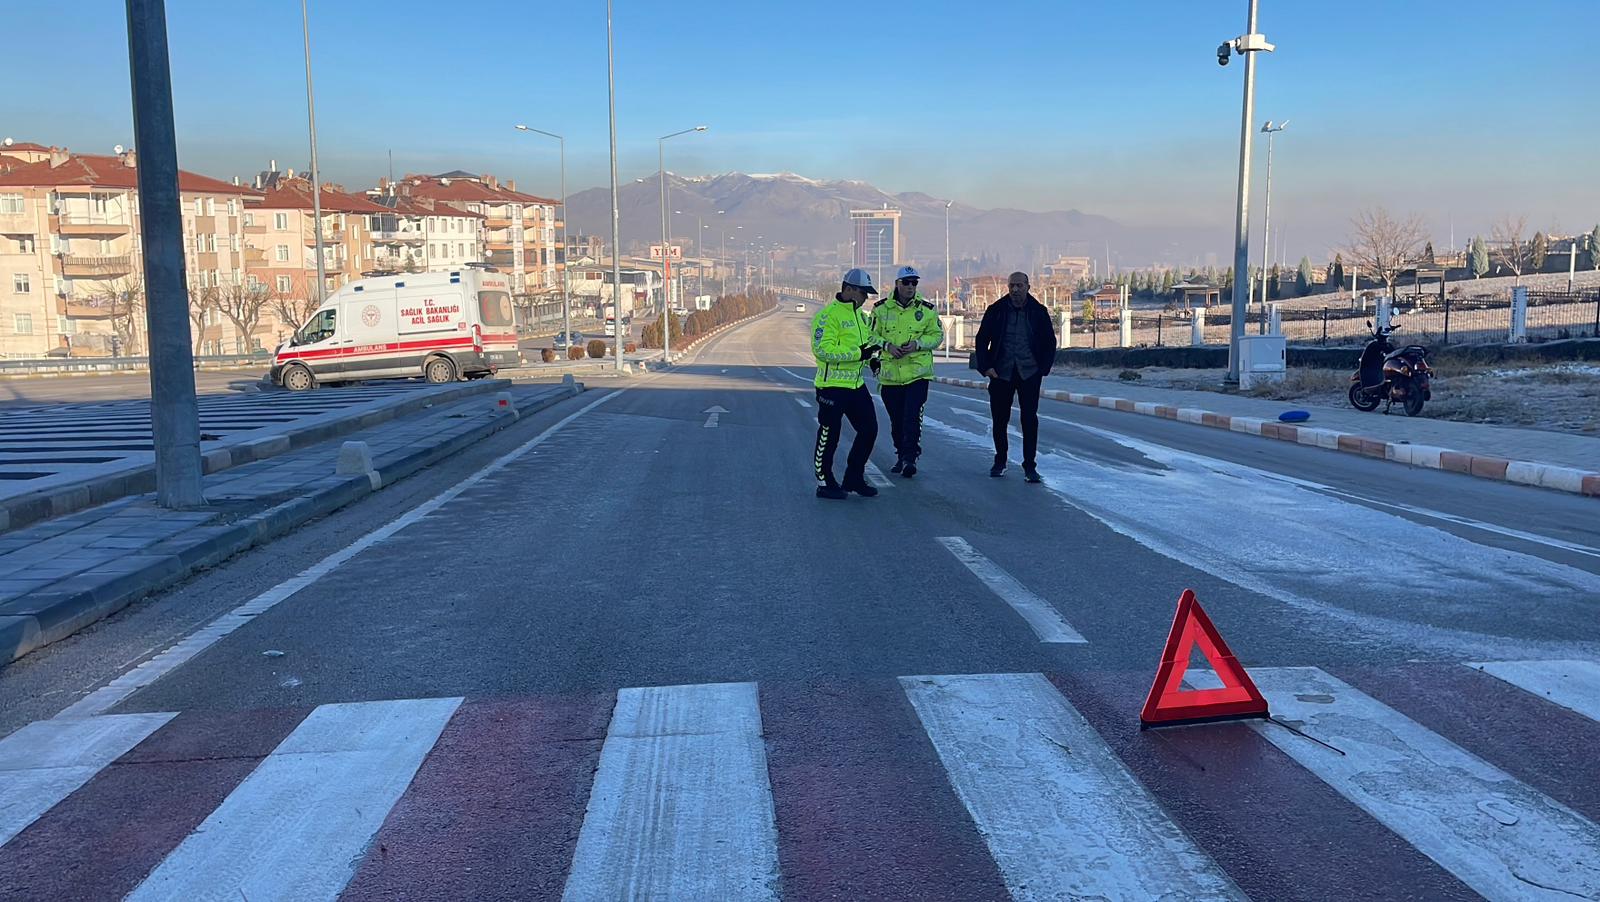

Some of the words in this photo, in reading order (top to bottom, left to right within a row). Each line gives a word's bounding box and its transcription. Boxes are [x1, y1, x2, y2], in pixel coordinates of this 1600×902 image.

[424, 299, 435, 307] T.C.
[401, 307, 423, 317] SAĞLIK
[426, 304, 460, 315] BAKANLIĞI
[427, 314, 450, 324] SAĞLIK
[353, 343, 387, 354] AMBULANS
